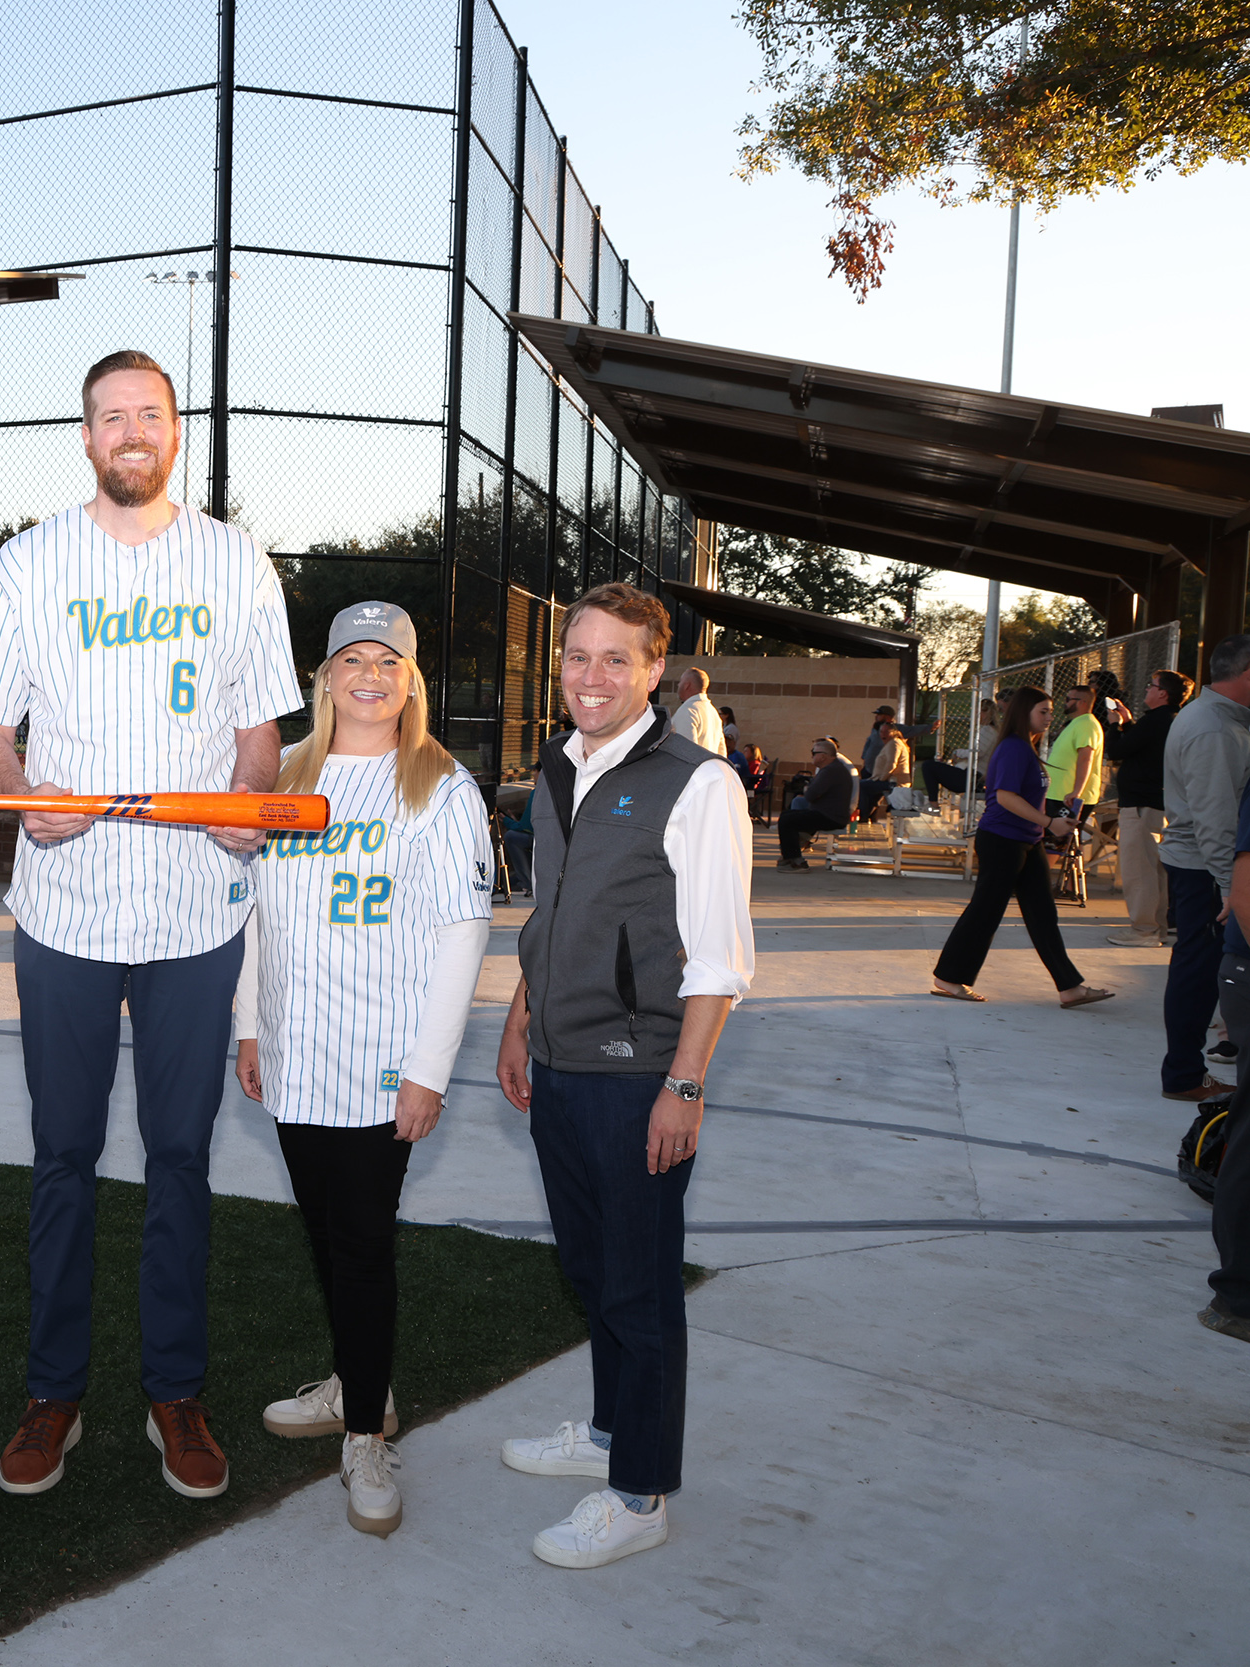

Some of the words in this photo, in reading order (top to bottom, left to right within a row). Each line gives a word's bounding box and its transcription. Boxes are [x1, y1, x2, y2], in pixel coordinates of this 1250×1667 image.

[67, 594, 212, 652] Valero
[353, 618, 388, 628] Valero
[168, 658, 197, 716] 6
[328, 870, 393, 926] 22
[382, 1073, 398, 1086] 22
